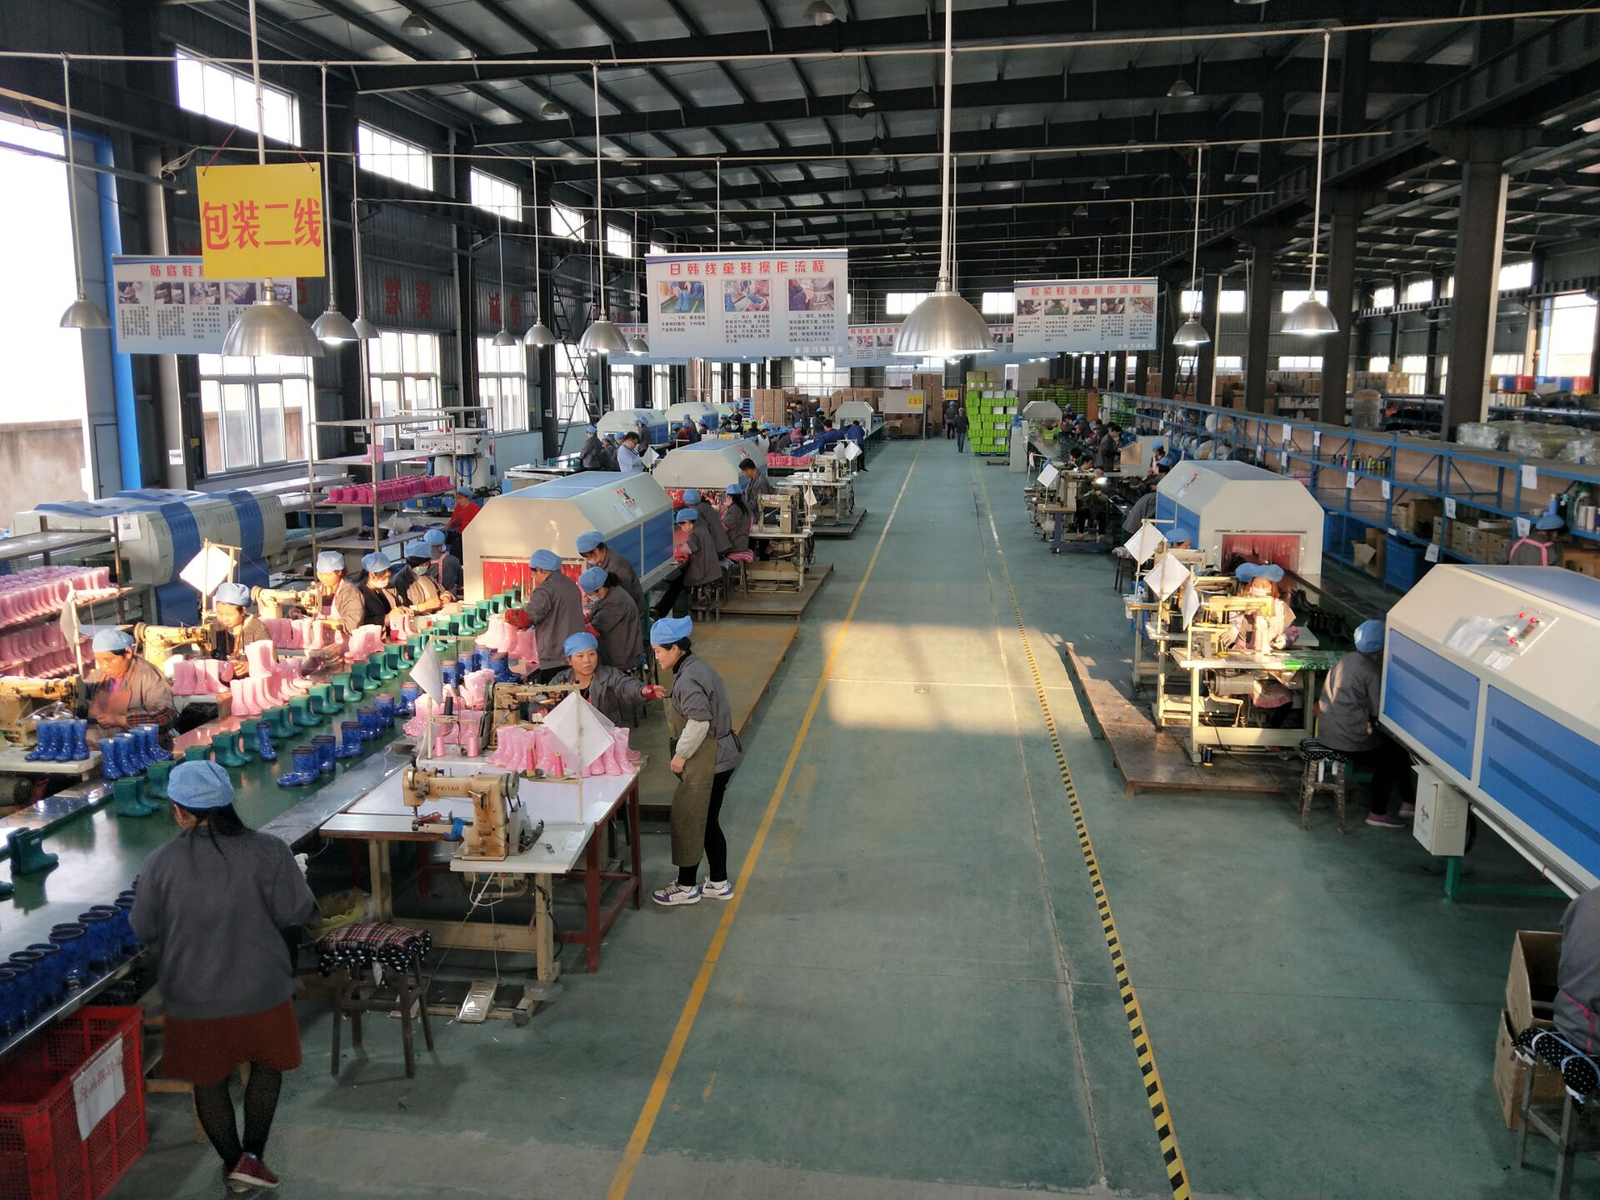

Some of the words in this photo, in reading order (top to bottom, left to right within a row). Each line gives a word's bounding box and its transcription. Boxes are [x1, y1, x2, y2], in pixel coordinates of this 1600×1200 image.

[202, 198, 321, 250] 包装二线
[669, 260, 825, 275] 日韩线童鞋操作流程
